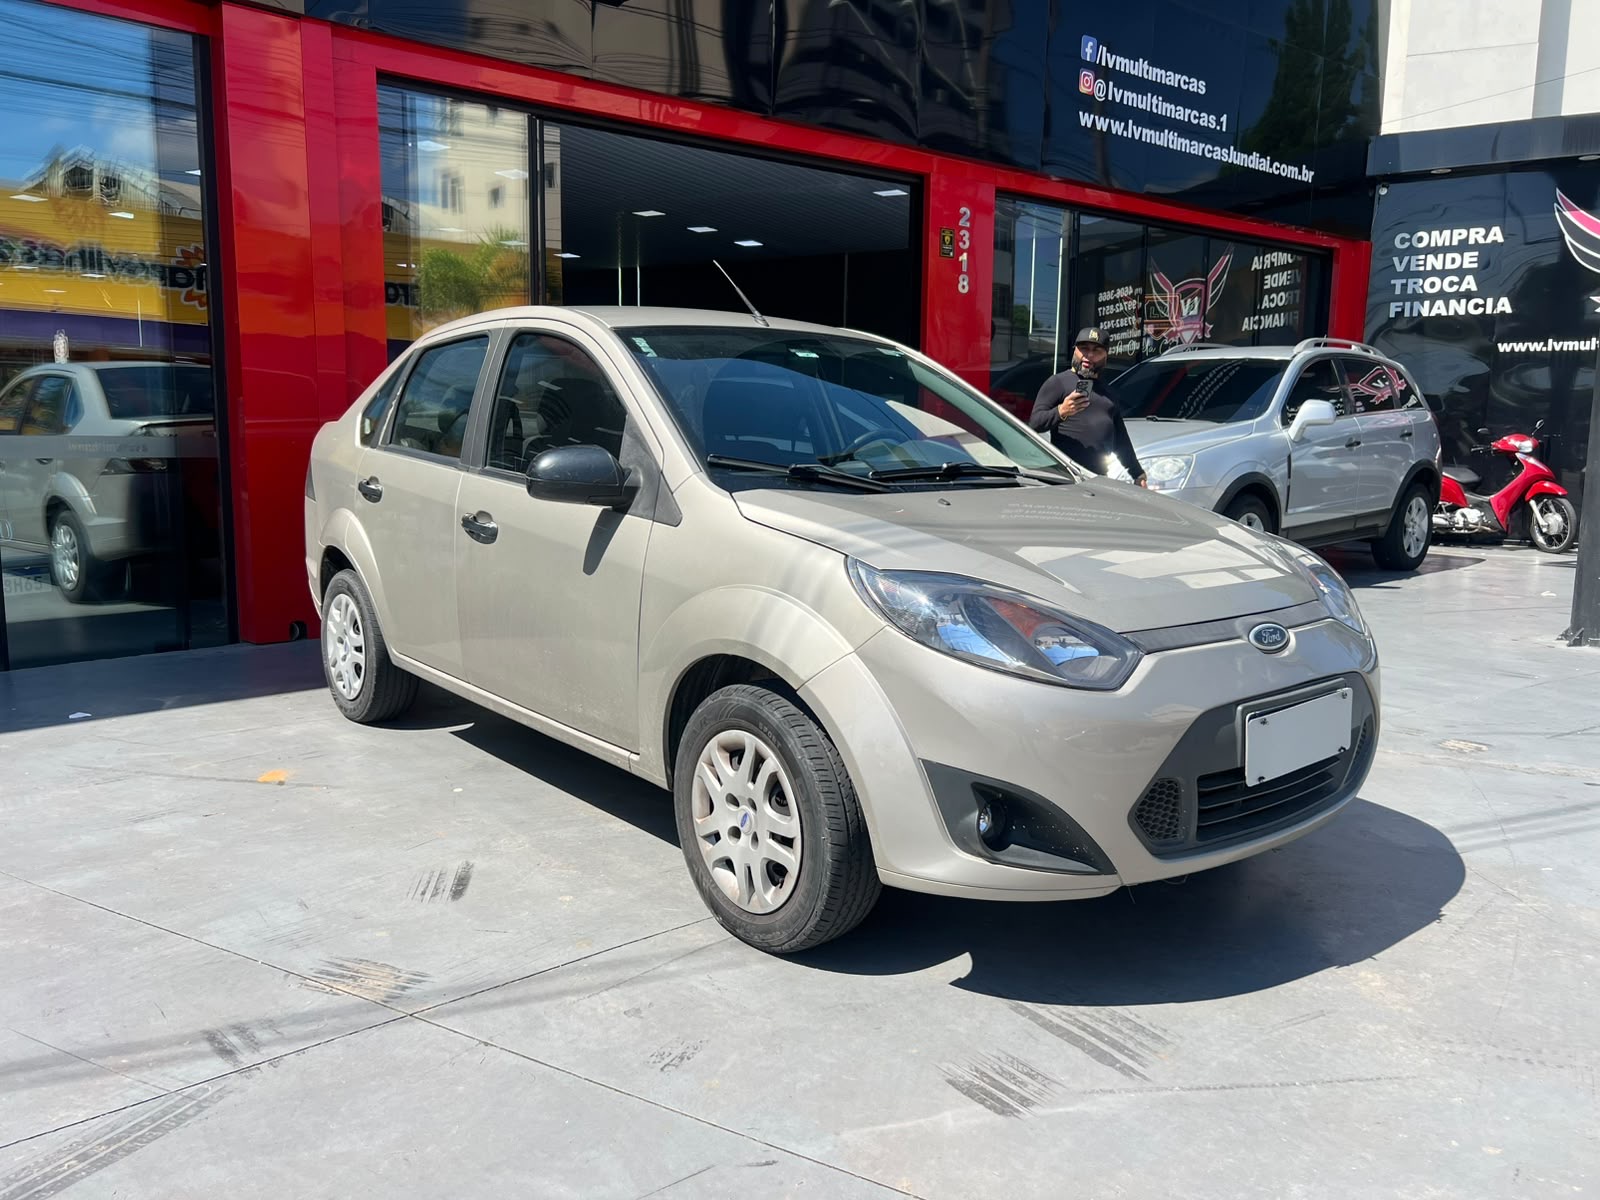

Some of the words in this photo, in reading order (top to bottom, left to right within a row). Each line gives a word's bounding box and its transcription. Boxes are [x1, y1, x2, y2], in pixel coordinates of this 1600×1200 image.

[1096, 45, 1206, 95] /lvmultimarcas
[1093, 79, 1228, 132] @lvmultimarcas.1
[1394, 226, 1504, 249] COMPRA
[958, 207, 971, 294] 2318
[1392, 251, 1479, 272] VENDE
[1390, 274, 1478, 295] TROCA
[1389, 297, 1513, 318] FINANCIA
[1497, 337, 1600, 353] www.lvmul
[1261, 628, 1281, 643] Ford
